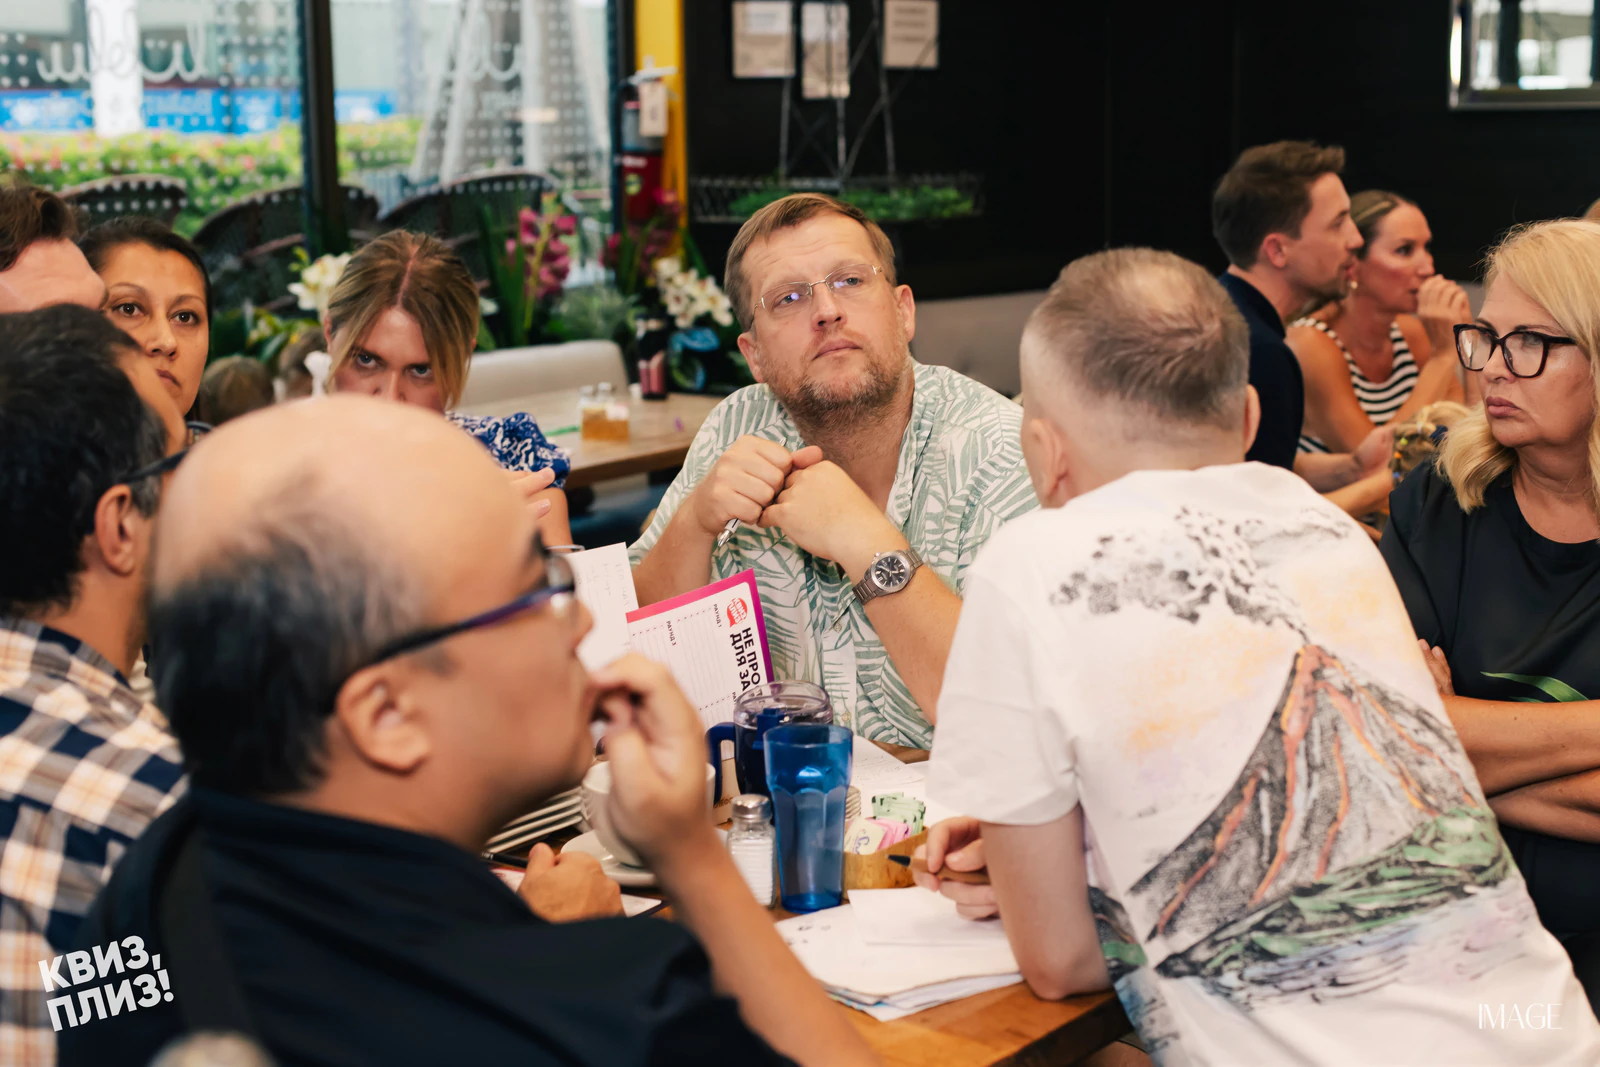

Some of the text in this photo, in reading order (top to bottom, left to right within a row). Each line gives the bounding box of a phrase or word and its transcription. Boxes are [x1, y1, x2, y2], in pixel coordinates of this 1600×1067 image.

[666, 620, 676, 642] РАУНД
[742, 627, 761, 686] НЕ ПРО
[730, 632, 752, 692] ДЛЯ ЗА
